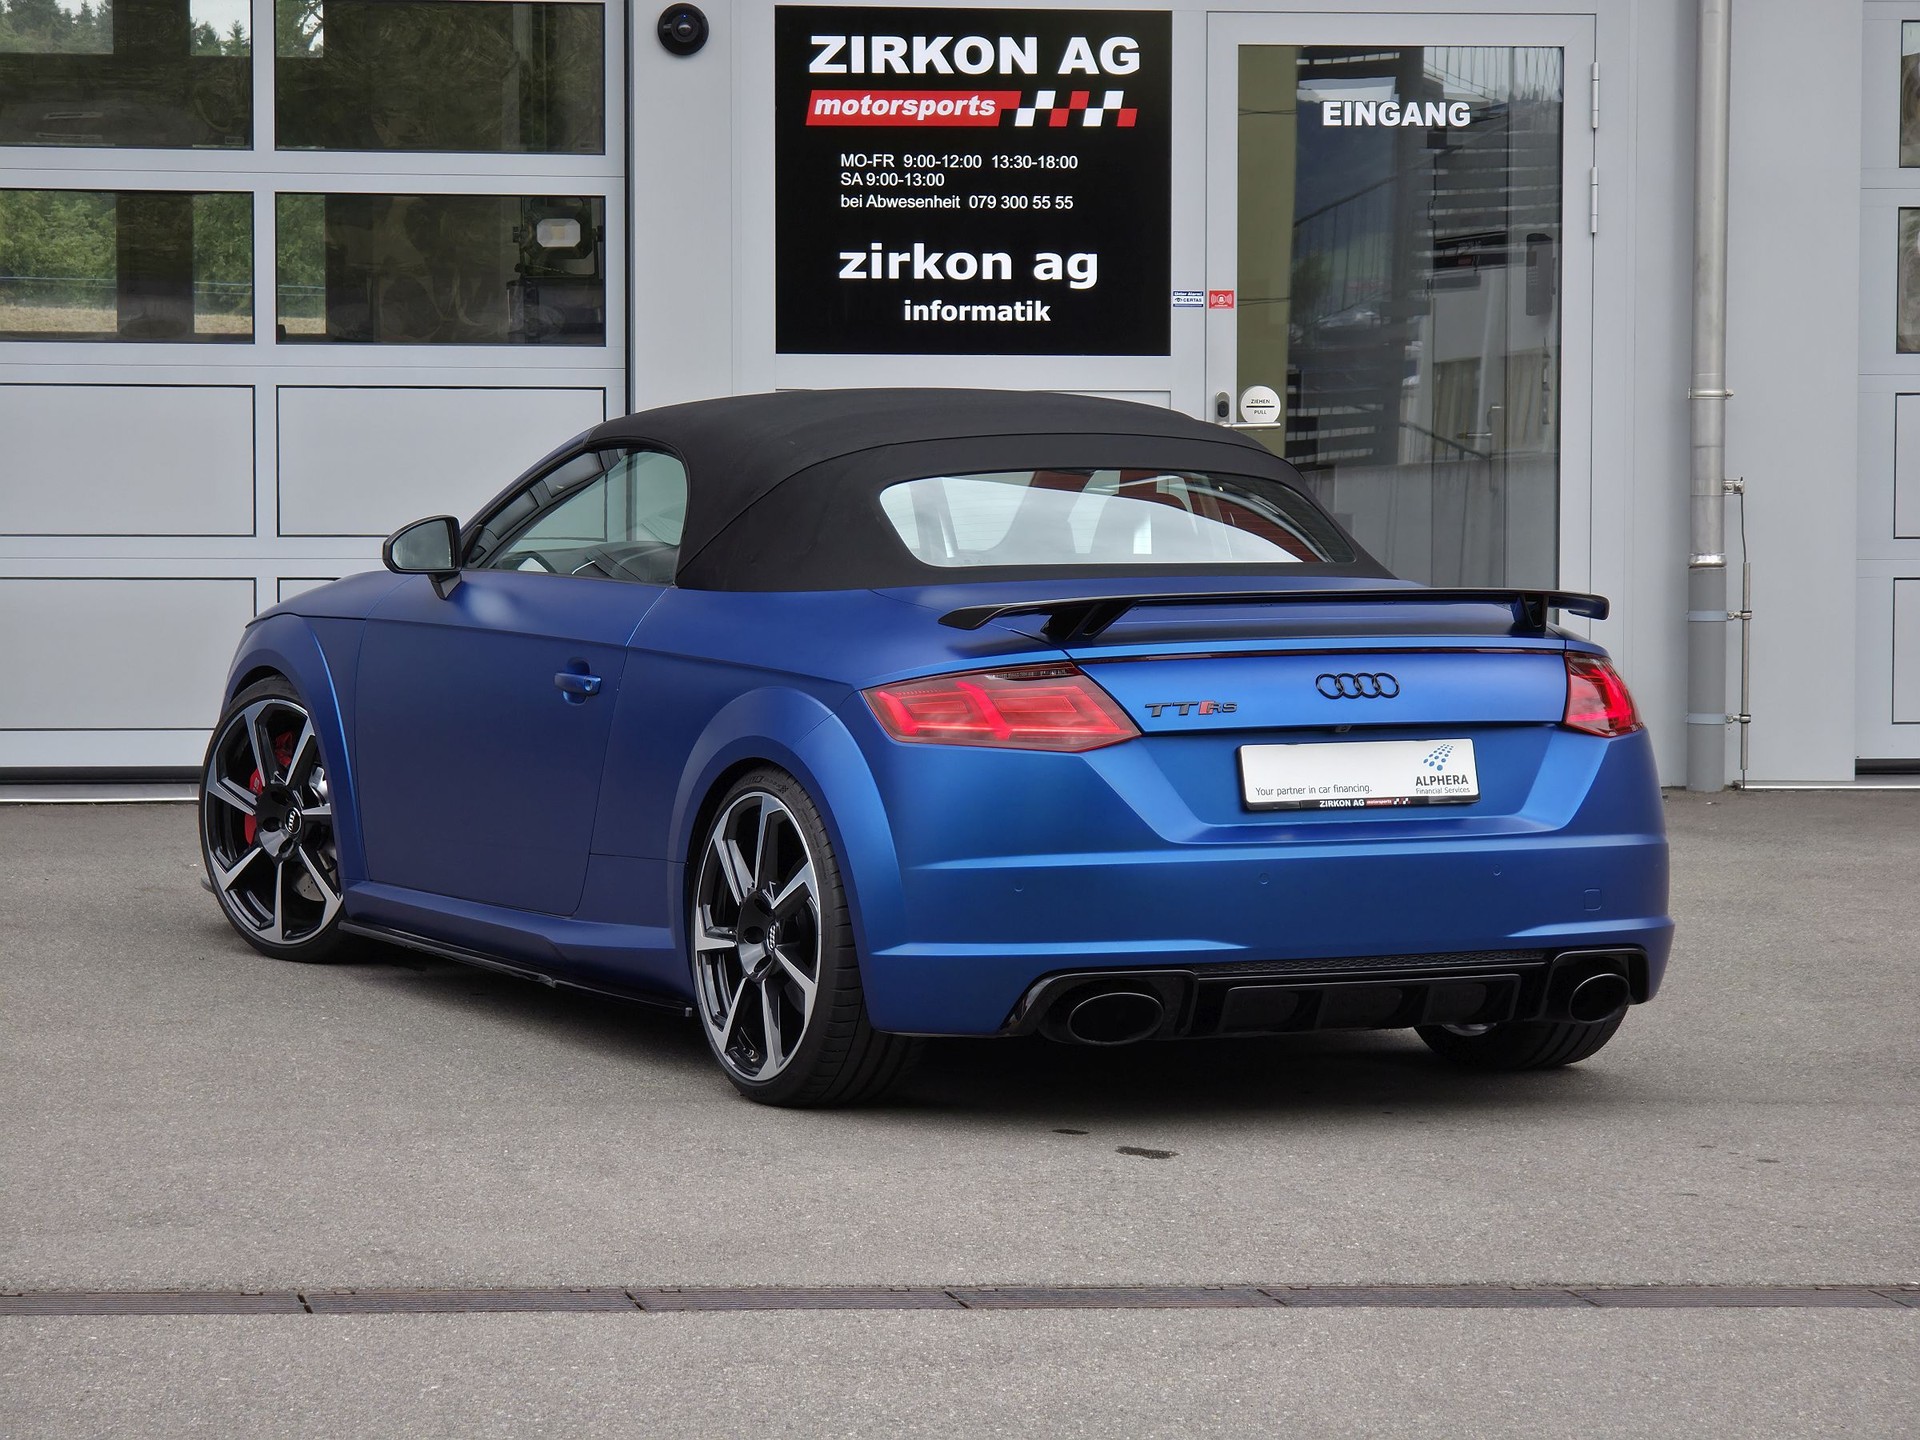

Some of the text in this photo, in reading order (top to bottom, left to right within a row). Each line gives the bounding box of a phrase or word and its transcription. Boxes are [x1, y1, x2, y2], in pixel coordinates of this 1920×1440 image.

[808, 35, 1141, 75] ZIRKON AG
[814, 94, 996, 121] motorsports
[1322, 101, 1471, 127] EINGANG
[840, 154, 1078, 169] MO-FR 9:00-12:00 13:30-18:00
[840, 172, 945, 186] SA 9:00-13:00
[840, 194, 1074, 209] bei Abwesenheit 079 300 55 55
[838, 242, 1099, 289] zirkon ag
[904, 300, 1051, 322] informatik
[1415, 774, 1469, 787] ALPHERA
[1255, 784, 1373, 797] Your partner in car financing.
[1415, 786, 1470, 795] Financial Services
[1319, 799, 1351, 808] ZIRKON
[1352, 799, 1365, 807] AG
